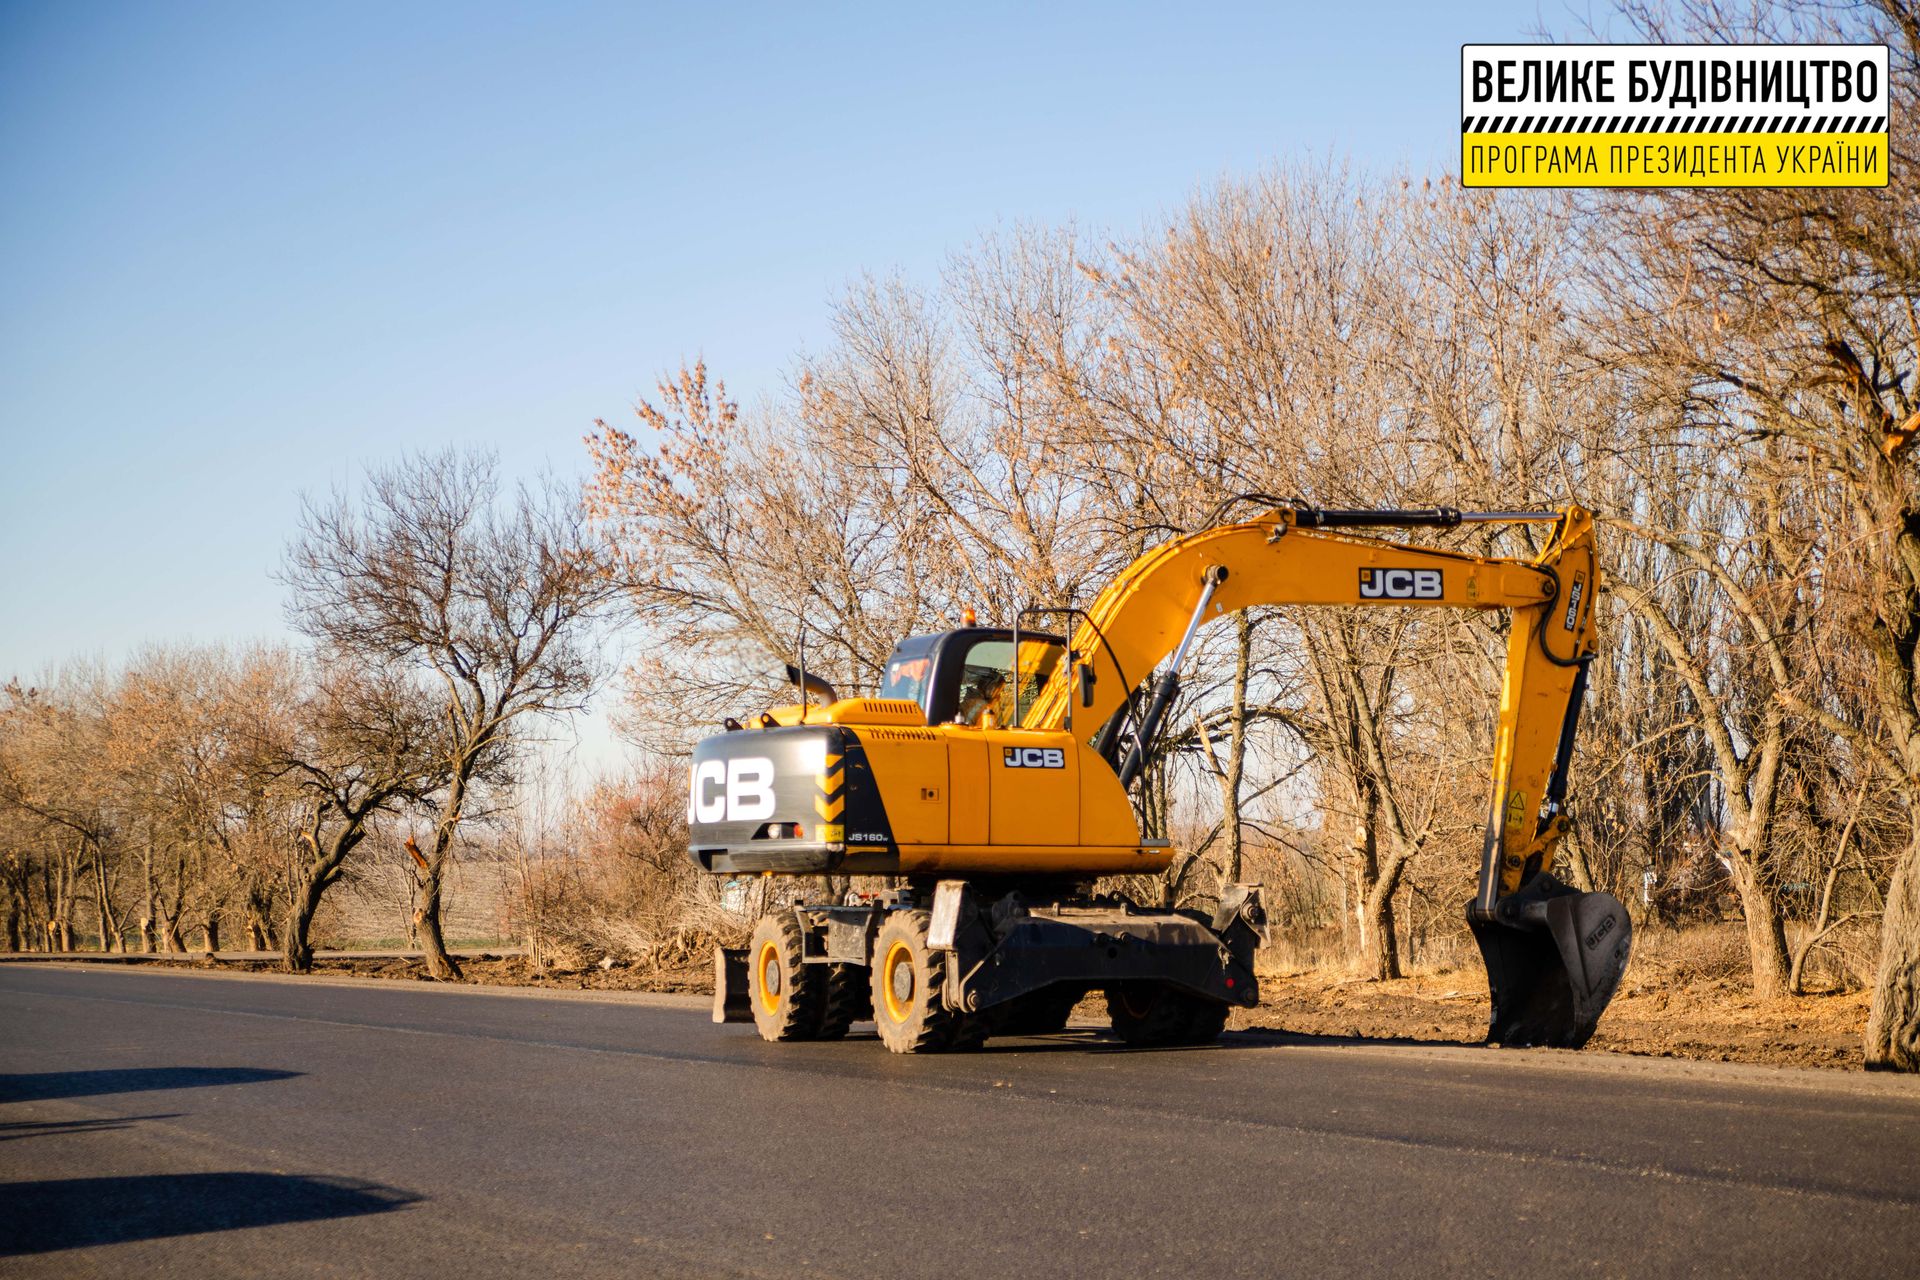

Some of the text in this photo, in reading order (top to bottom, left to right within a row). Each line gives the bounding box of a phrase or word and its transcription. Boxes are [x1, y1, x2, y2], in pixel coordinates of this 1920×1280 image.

[1361, 569, 1442, 598] JCB
[1005, 748, 1064, 767] JCB
[1586, 916, 1616, 949] JCB
